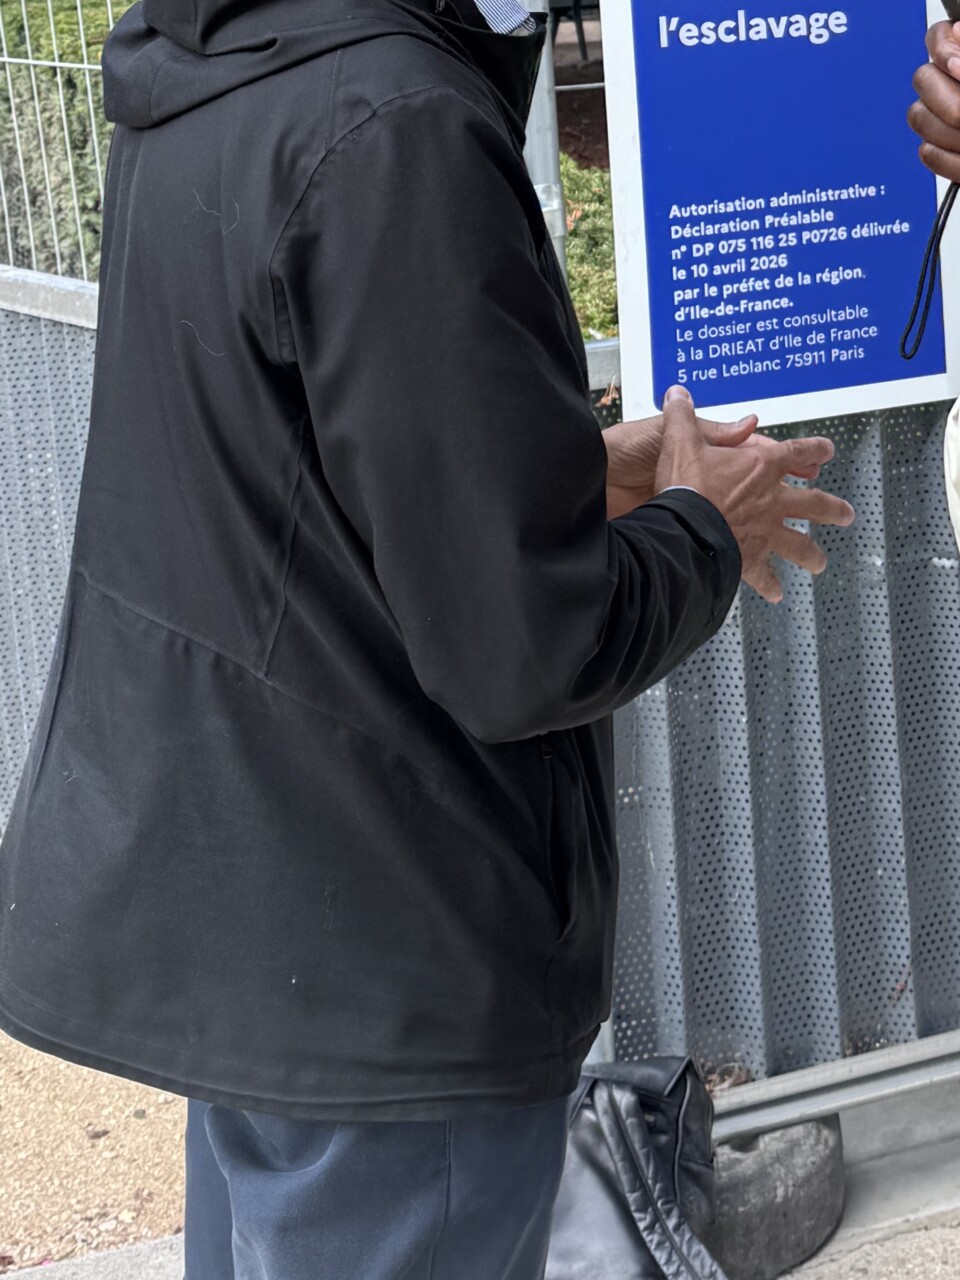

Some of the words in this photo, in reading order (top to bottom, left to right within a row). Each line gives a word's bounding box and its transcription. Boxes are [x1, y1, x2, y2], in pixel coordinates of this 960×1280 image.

[658, 10, 848, 48] l'esclavage
[669, 196, 765, 220] Autorisation
[770, 184, 876, 208] administrative
[880, 186, 886, 196] :
[670, 217, 760, 240] Déclaration
[764, 209, 834, 229] Préalable
[671, 245, 687, 260] n°
[692, 240, 714, 257] DP
[718, 238, 746, 254] 075
[750, 236, 774, 251] 116
[778, 232, 798, 248] 25
[802, 226, 848, 245] P0726
[851, 221, 910, 240] délivrée
[672, 266, 688, 280] le
[690, 263, 708, 278] 10
[712, 258, 746, 276] avril
[750, 254, 788, 271] 2026
[674, 288, 700, 306] par
[704, 284, 718, 298] le
[722, 276, 770, 299] préfet
[774, 273, 794, 288] de
[798, 270, 812, 286] la
[676, 328, 694, 342] Le
[698, 321, 751, 340] dossier
[756, 317, 779, 331] est
[783, 304, 868, 328] consultable
[676, 348, 686, 362] à
[690, 346, 703, 360] la
[708, 338, 765, 359] DRIEAT
[806, 330, 825, 346] de
[830, 324, 878, 344] France
[678, 368, 688, 384] 5
[692, 366, 717, 382] rue
[722, 358, 781, 378] Leblanc
[786, 350, 826, 368] 75911
[831, 344, 865, 364] Paris
